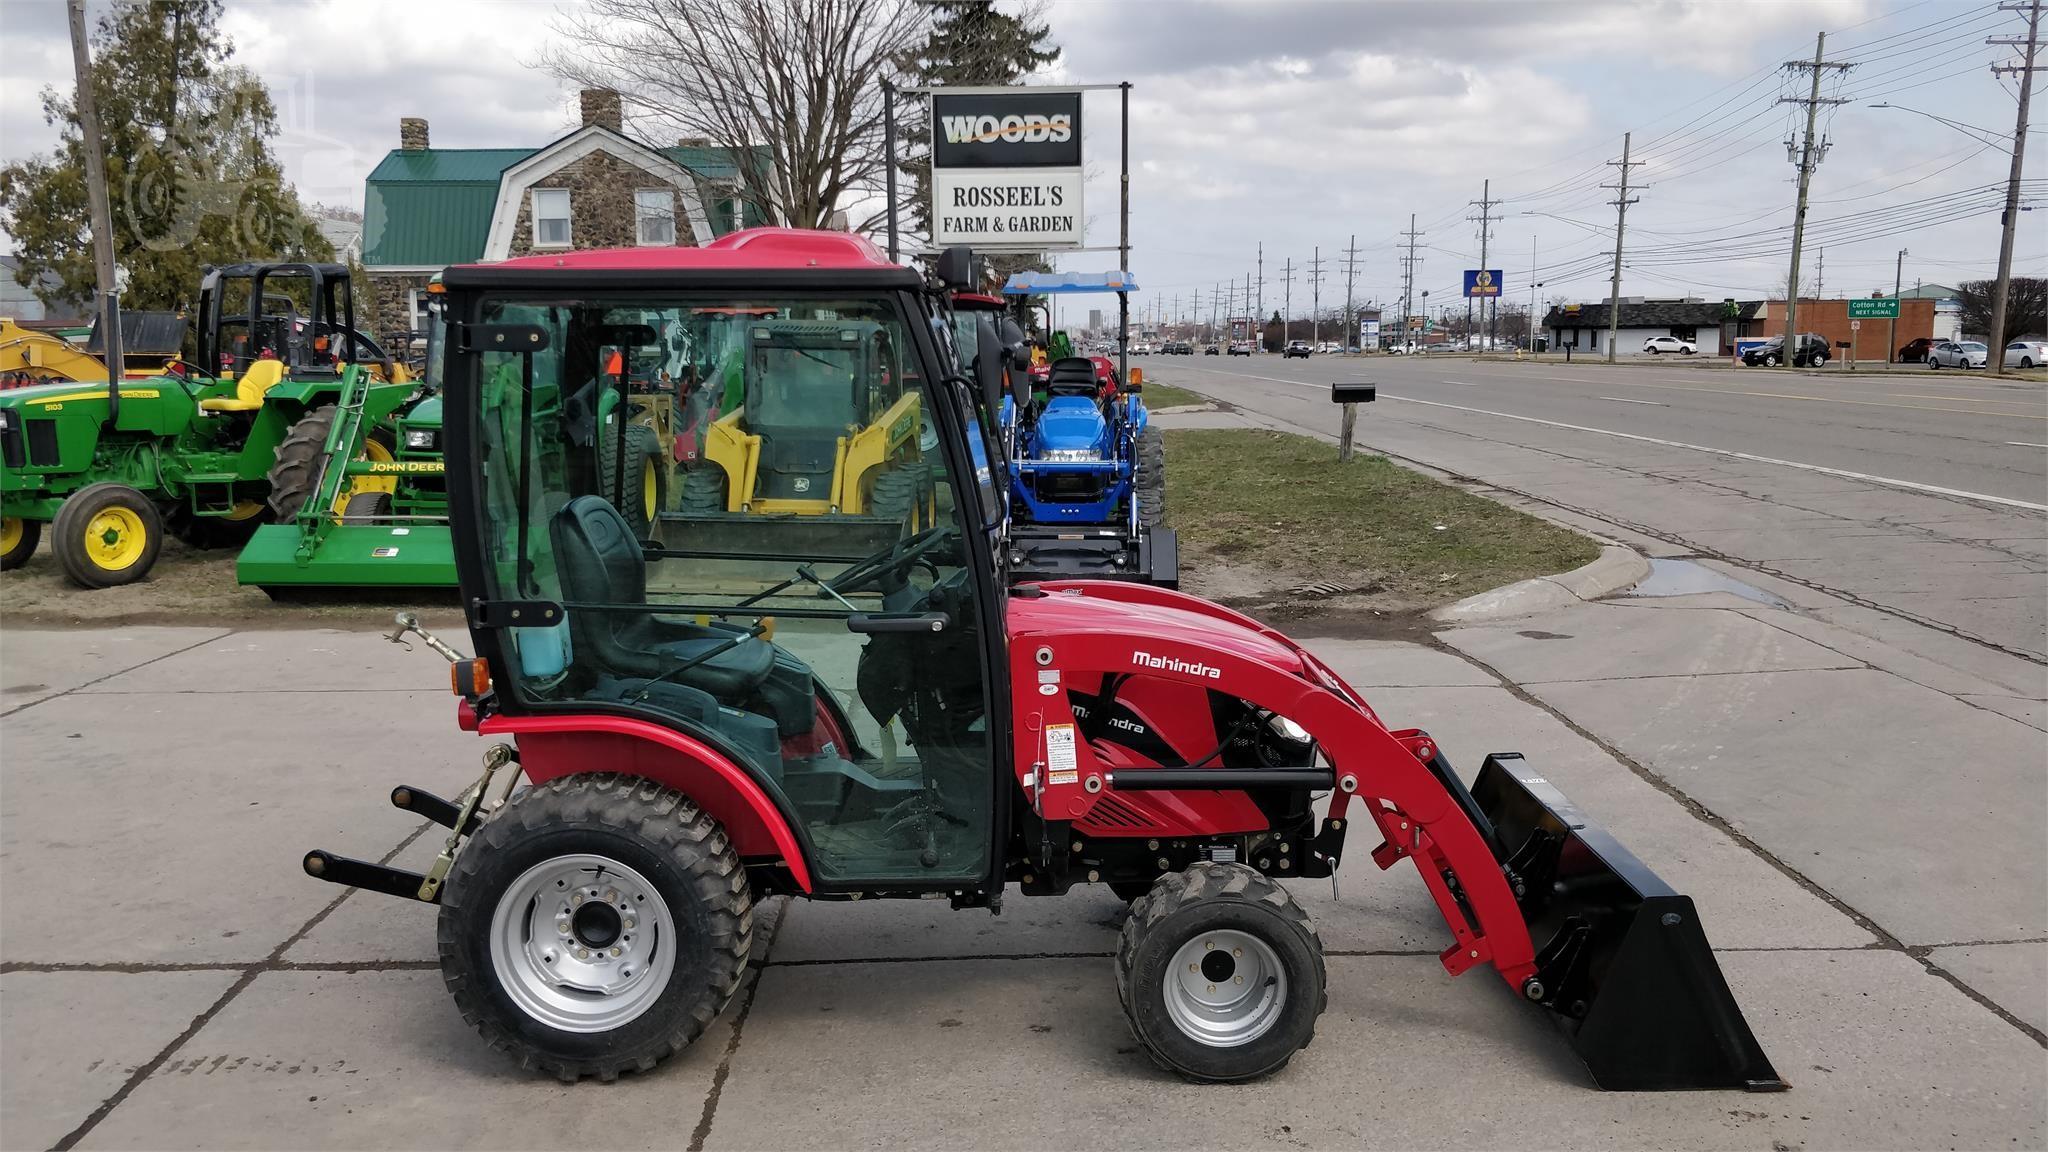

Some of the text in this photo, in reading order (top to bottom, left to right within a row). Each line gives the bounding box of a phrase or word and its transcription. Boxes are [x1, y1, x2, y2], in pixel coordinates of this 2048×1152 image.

[942, 114, 1072, 144] WOODS
[953, 186, 1063, 207] ROSSEEL'S
[943, 216, 1073, 233] FARM & GARDEN
[369, 463, 446, 472] JOHN DEER
[1132, 651, 1221, 679] Mahindra
[1071, 704, 1145, 734] Mndra
